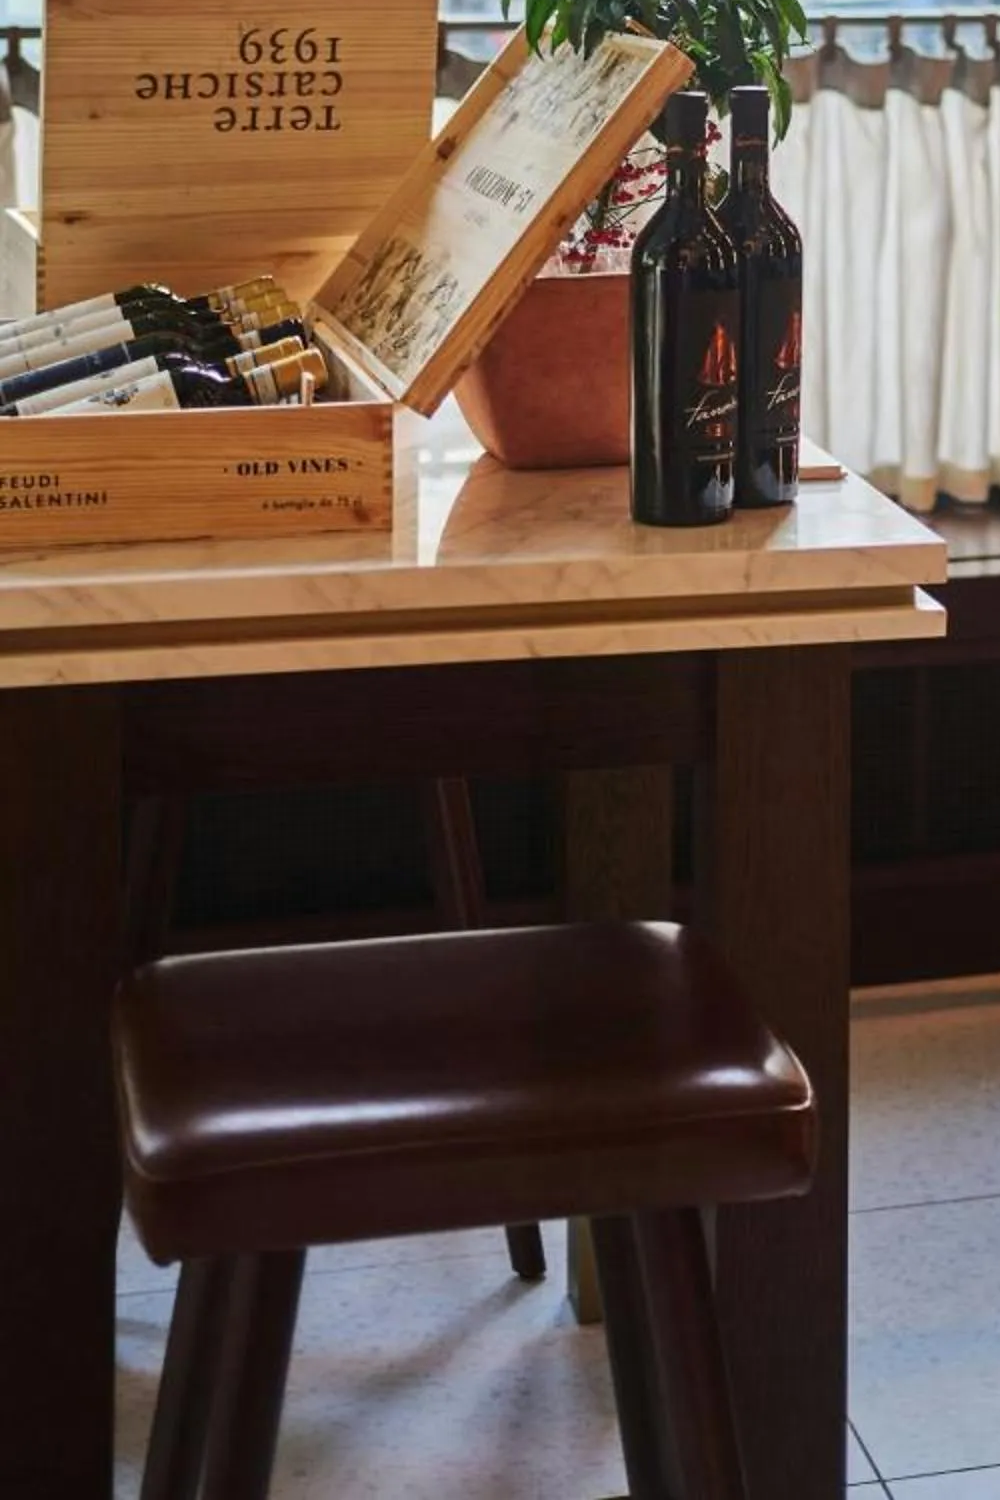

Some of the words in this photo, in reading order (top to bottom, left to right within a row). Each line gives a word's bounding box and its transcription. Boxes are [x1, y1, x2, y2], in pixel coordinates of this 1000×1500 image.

[239, 28, 342, 65] 1939
[237, 461, 279, 476] OLD
[287, 458, 348, 474] VINES
[0, 474, 59, 489] FEUDI
[0, 490, 107, 509] SALENTINI
